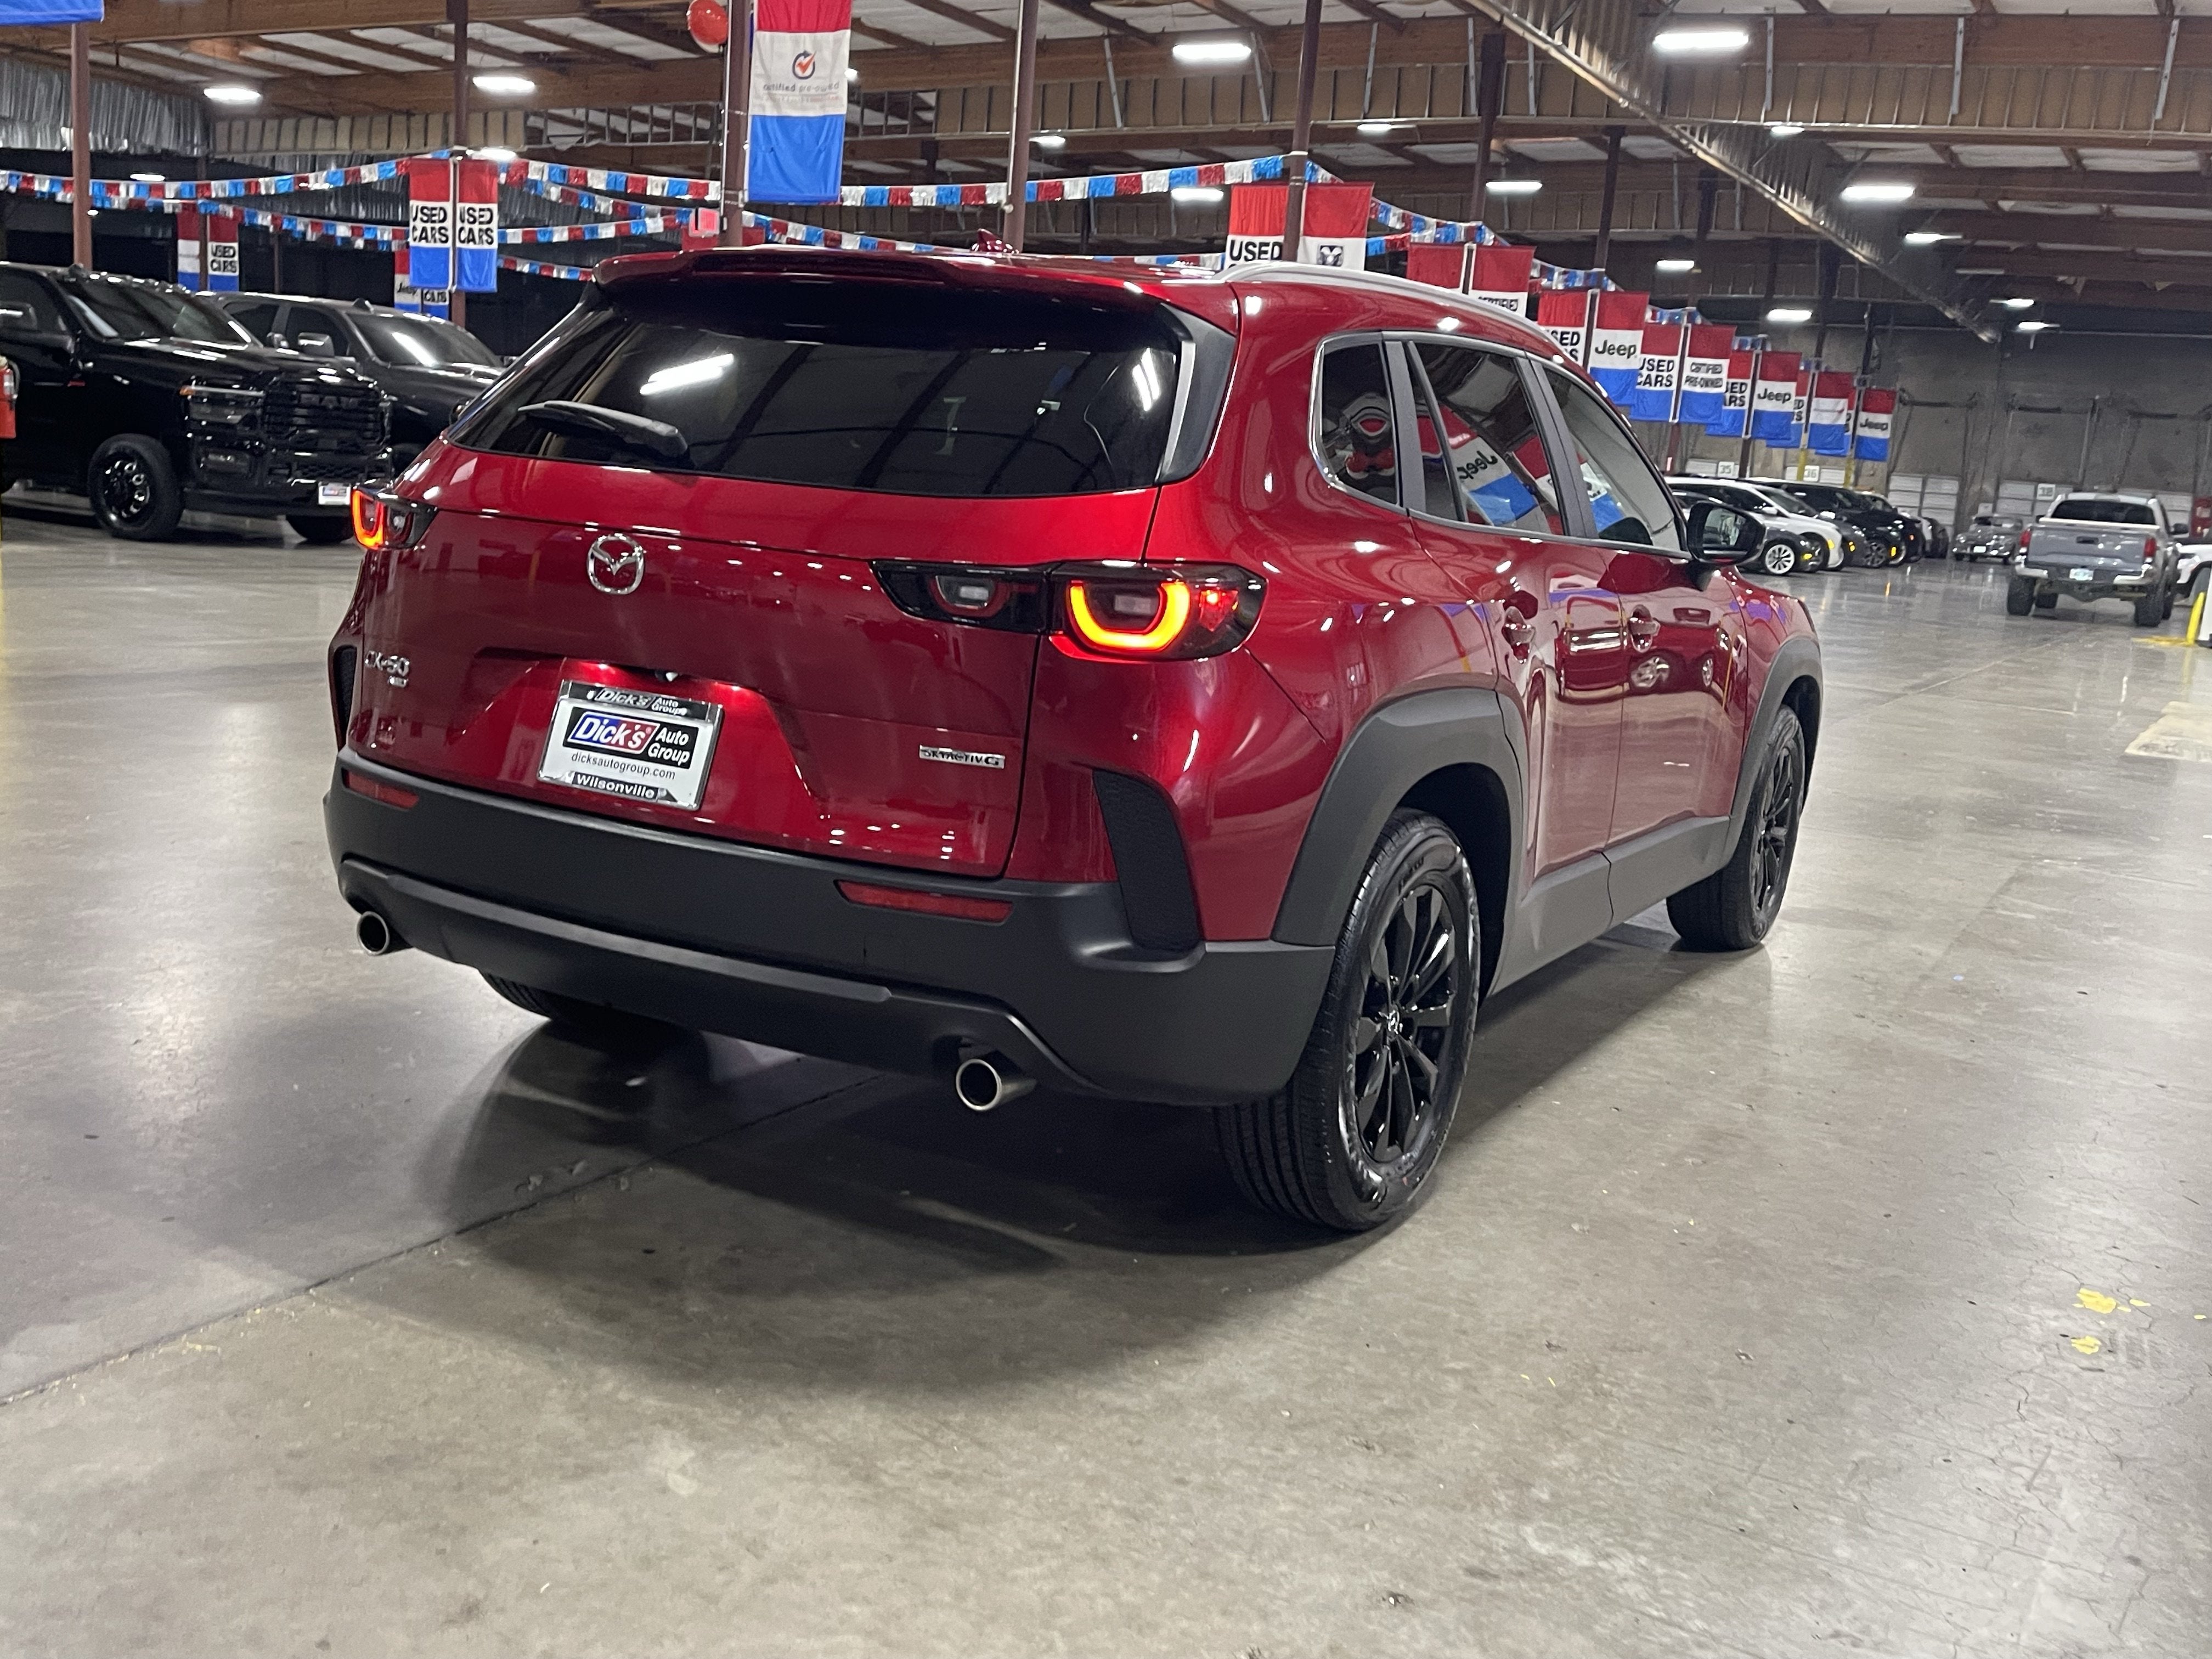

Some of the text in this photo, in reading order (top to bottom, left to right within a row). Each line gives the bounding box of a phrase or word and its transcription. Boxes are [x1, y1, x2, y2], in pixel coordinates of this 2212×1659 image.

[799, 82, 840, 93] pre-owed
[411, 205, 448, 224] USED
[459, 206, 493, 225] USED
[412, 225, 449, 244] CARS
[458, 227, 494, 245] CARS
[1229, 240, 1283, 262] USED
[1547, 330, 1581, 346] SED
[1595, 340, 1637, 359] Jeep
[1639, 358, 1674, 373] USED
[1637, 373, 1673, 387] CARS
[1757, 388, 1792, 404] Jeep
[1860, 417, 1889, 431] Jeep
[657, 697, 679, 708] Auto
[655, 727, 690, 746] Auto
[647, 742, 691, 766] Group
[571, 752, 676, 781] dicksautogroup.com
[577, 773, 656, 799] Wilsonville
